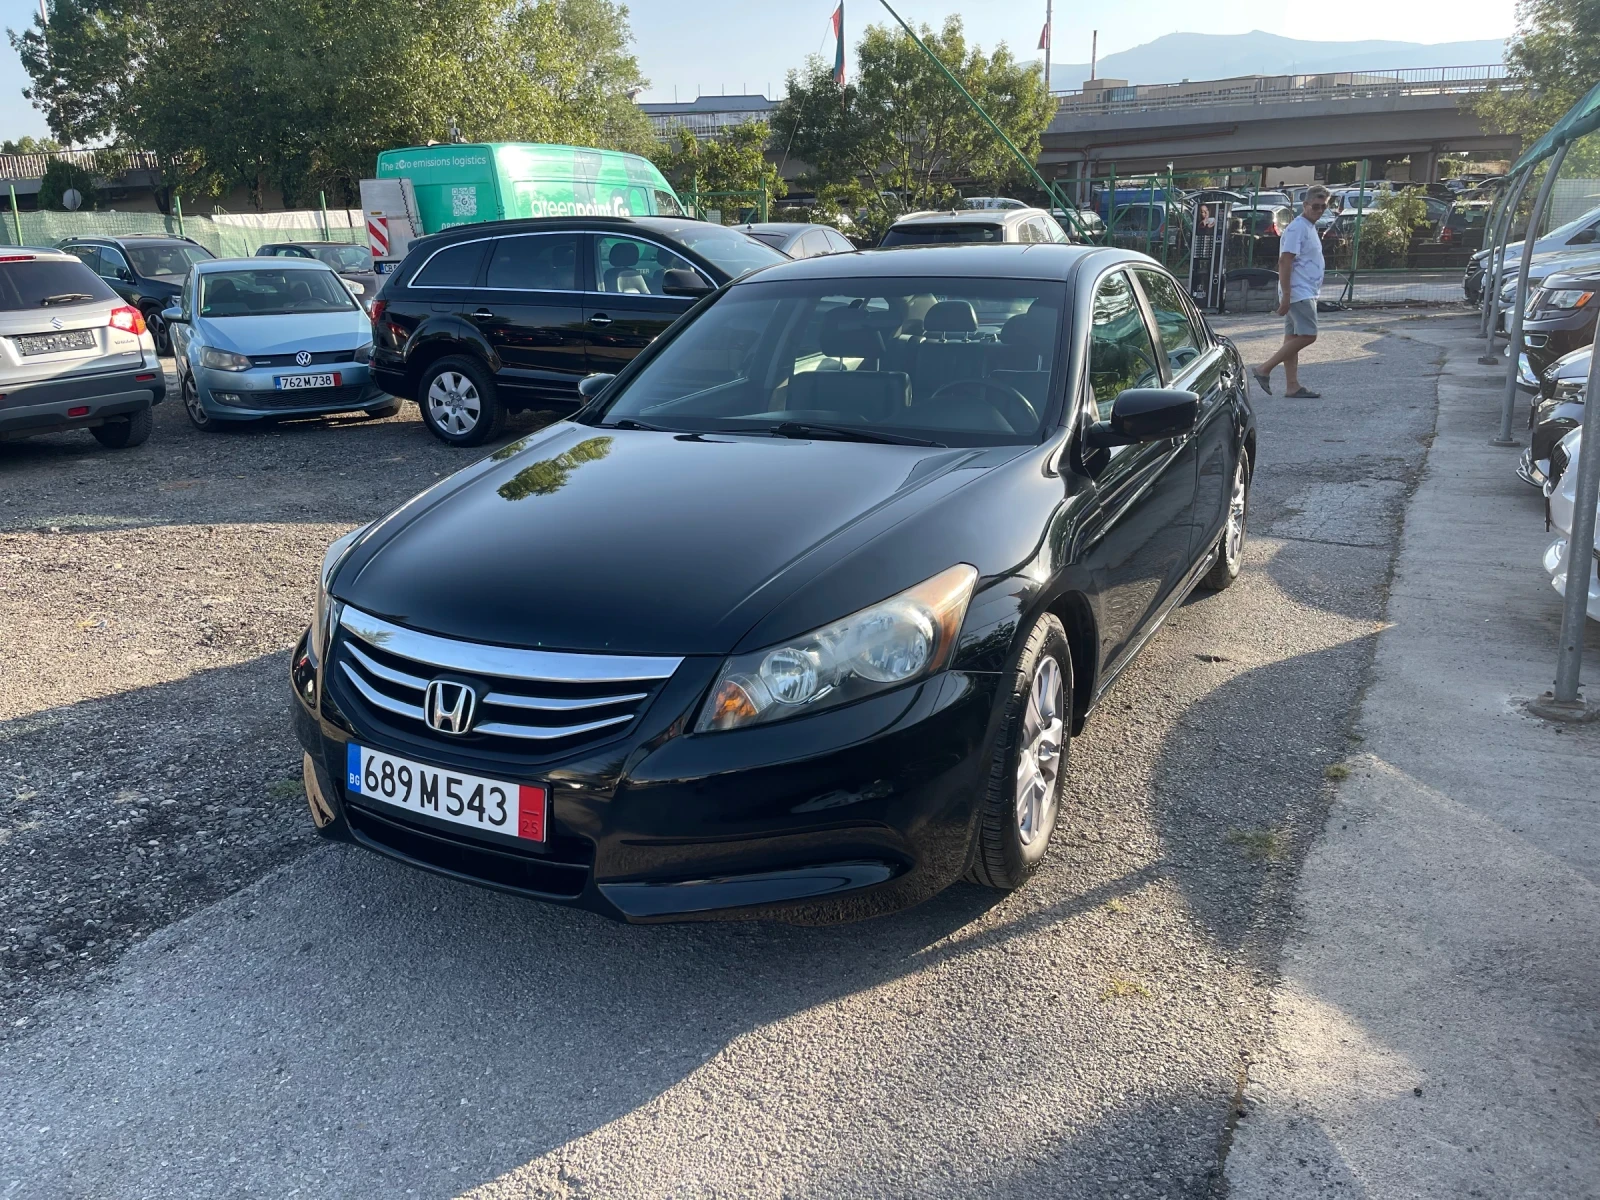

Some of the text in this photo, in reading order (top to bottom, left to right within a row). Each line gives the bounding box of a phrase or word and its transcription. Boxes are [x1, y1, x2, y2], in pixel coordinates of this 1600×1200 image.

[381, 162, 394, 171] The
[413, 158, 451, 168] emissions
[452, 156, 487, 167] logistics
[349, 772, 360, 786] BG
[522, 819, 539, 835] 25
